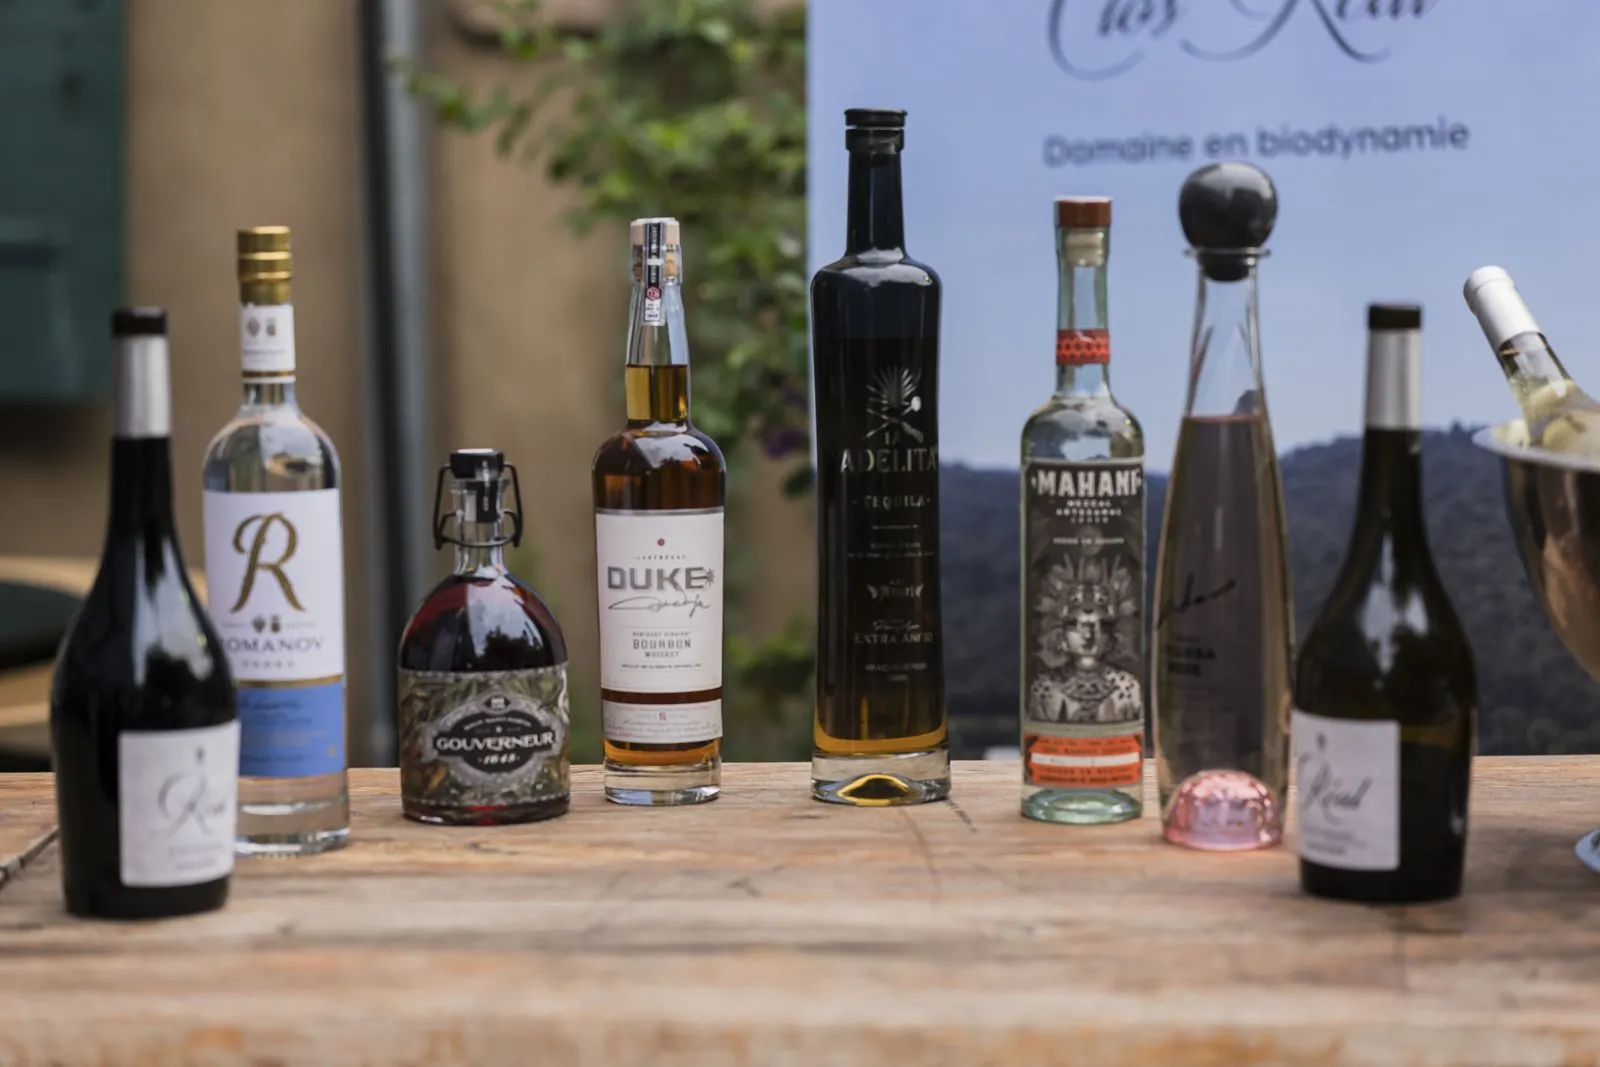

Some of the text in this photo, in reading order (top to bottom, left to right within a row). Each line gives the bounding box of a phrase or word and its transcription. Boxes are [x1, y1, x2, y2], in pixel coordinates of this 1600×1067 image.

[1043, 116, 1470, 168] Domaine en biodynamie
[840, 445, 938, 473] ADELITA
[230, 511, 307, 615] R
[607, 566, 707, 592] DUKE
[223, 636, 324, 653] OMANOV
[632, 638, 692, 650] BOURBON
[435, 731, 554, 750] GOUVERNEUR
